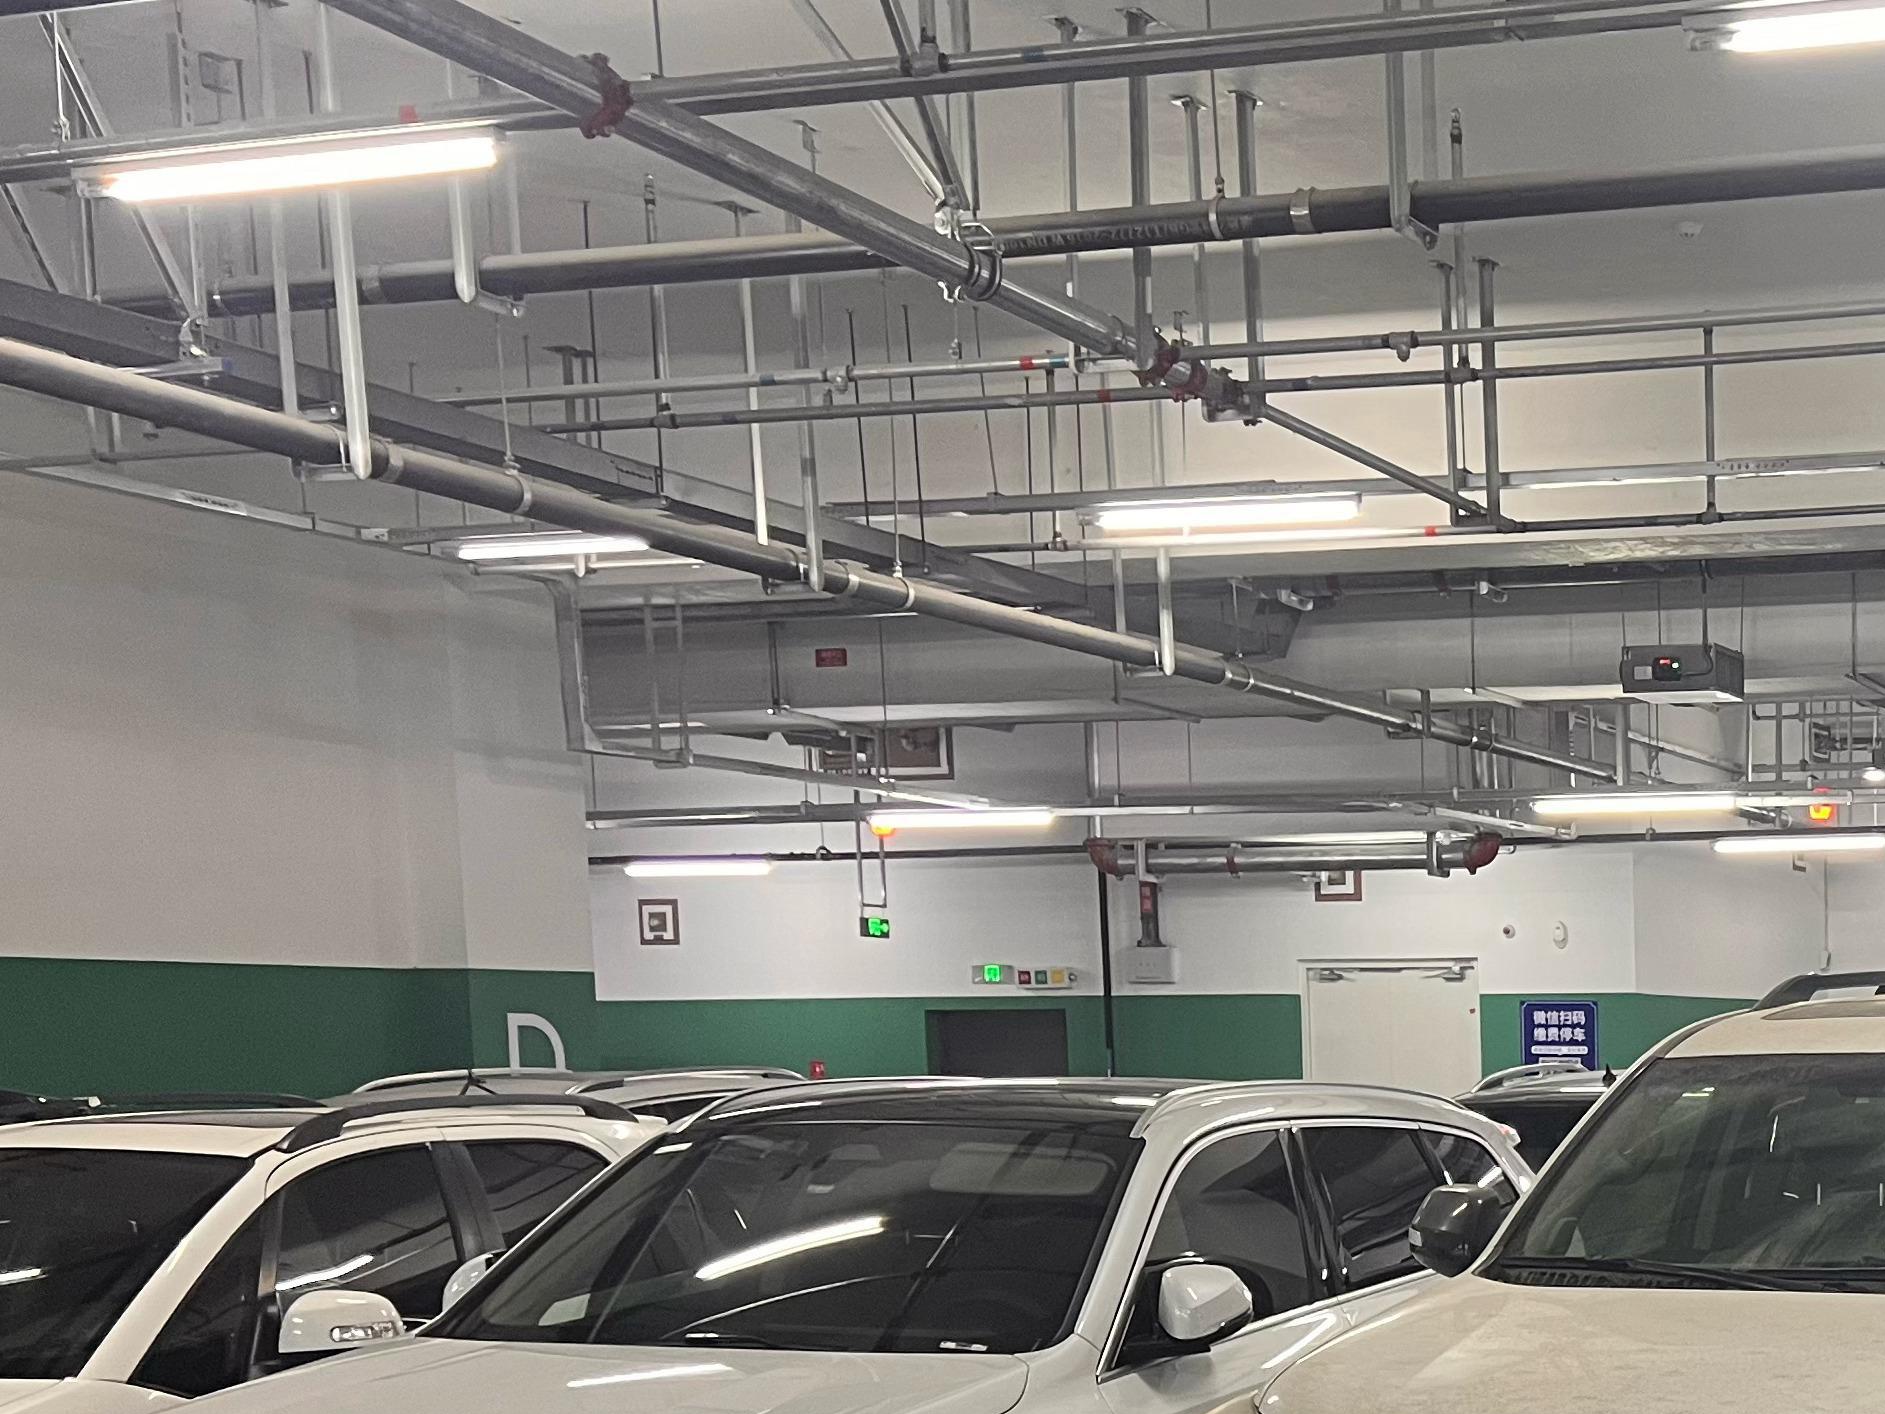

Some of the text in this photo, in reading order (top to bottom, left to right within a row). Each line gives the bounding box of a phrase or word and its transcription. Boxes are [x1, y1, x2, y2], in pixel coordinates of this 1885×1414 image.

[1533, 1010, 1586, 1025] 微信扫码
[1533, 1027, 1586, 1042] 缴费停车
[507, 1013, 566, 1073] D
